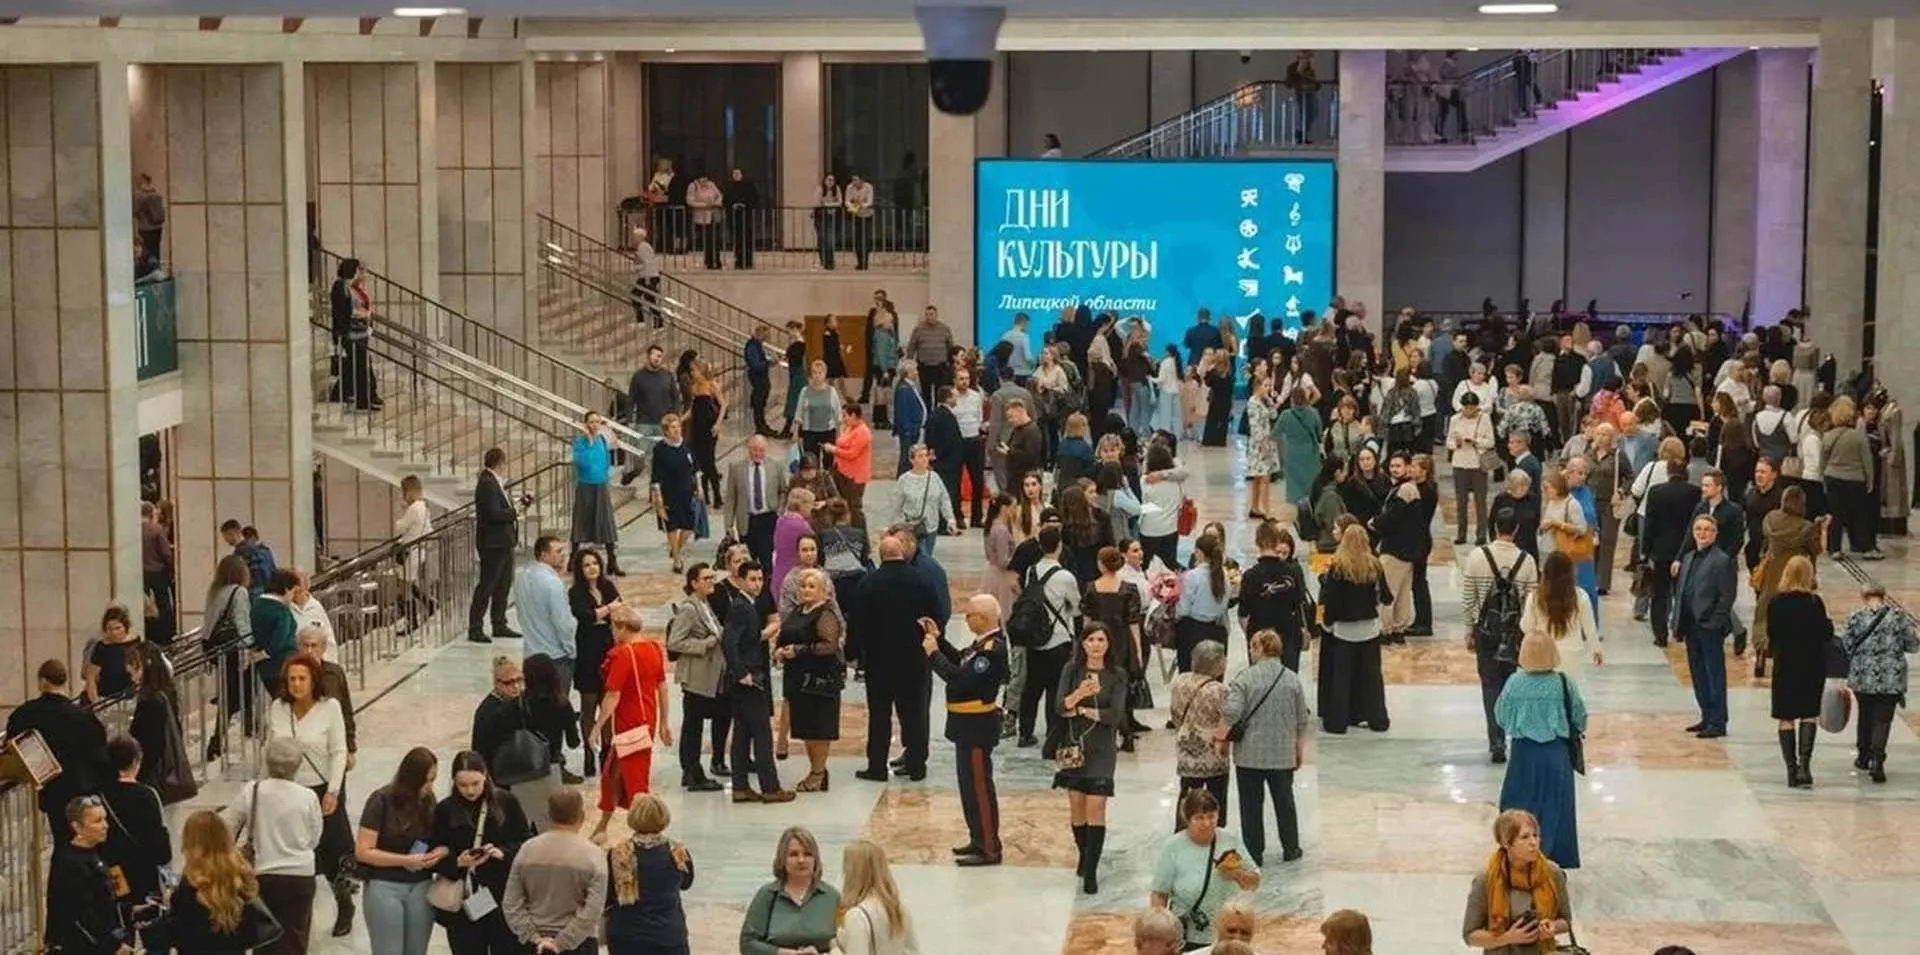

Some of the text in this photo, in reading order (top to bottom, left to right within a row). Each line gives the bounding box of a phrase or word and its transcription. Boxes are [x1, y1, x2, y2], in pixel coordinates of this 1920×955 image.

[999, 189, 1069, 233] ДНИ
[998, 240, 1158, 279] КУЛЬТУРЫ
[998, 294, 1157, 312] Липецкой области
